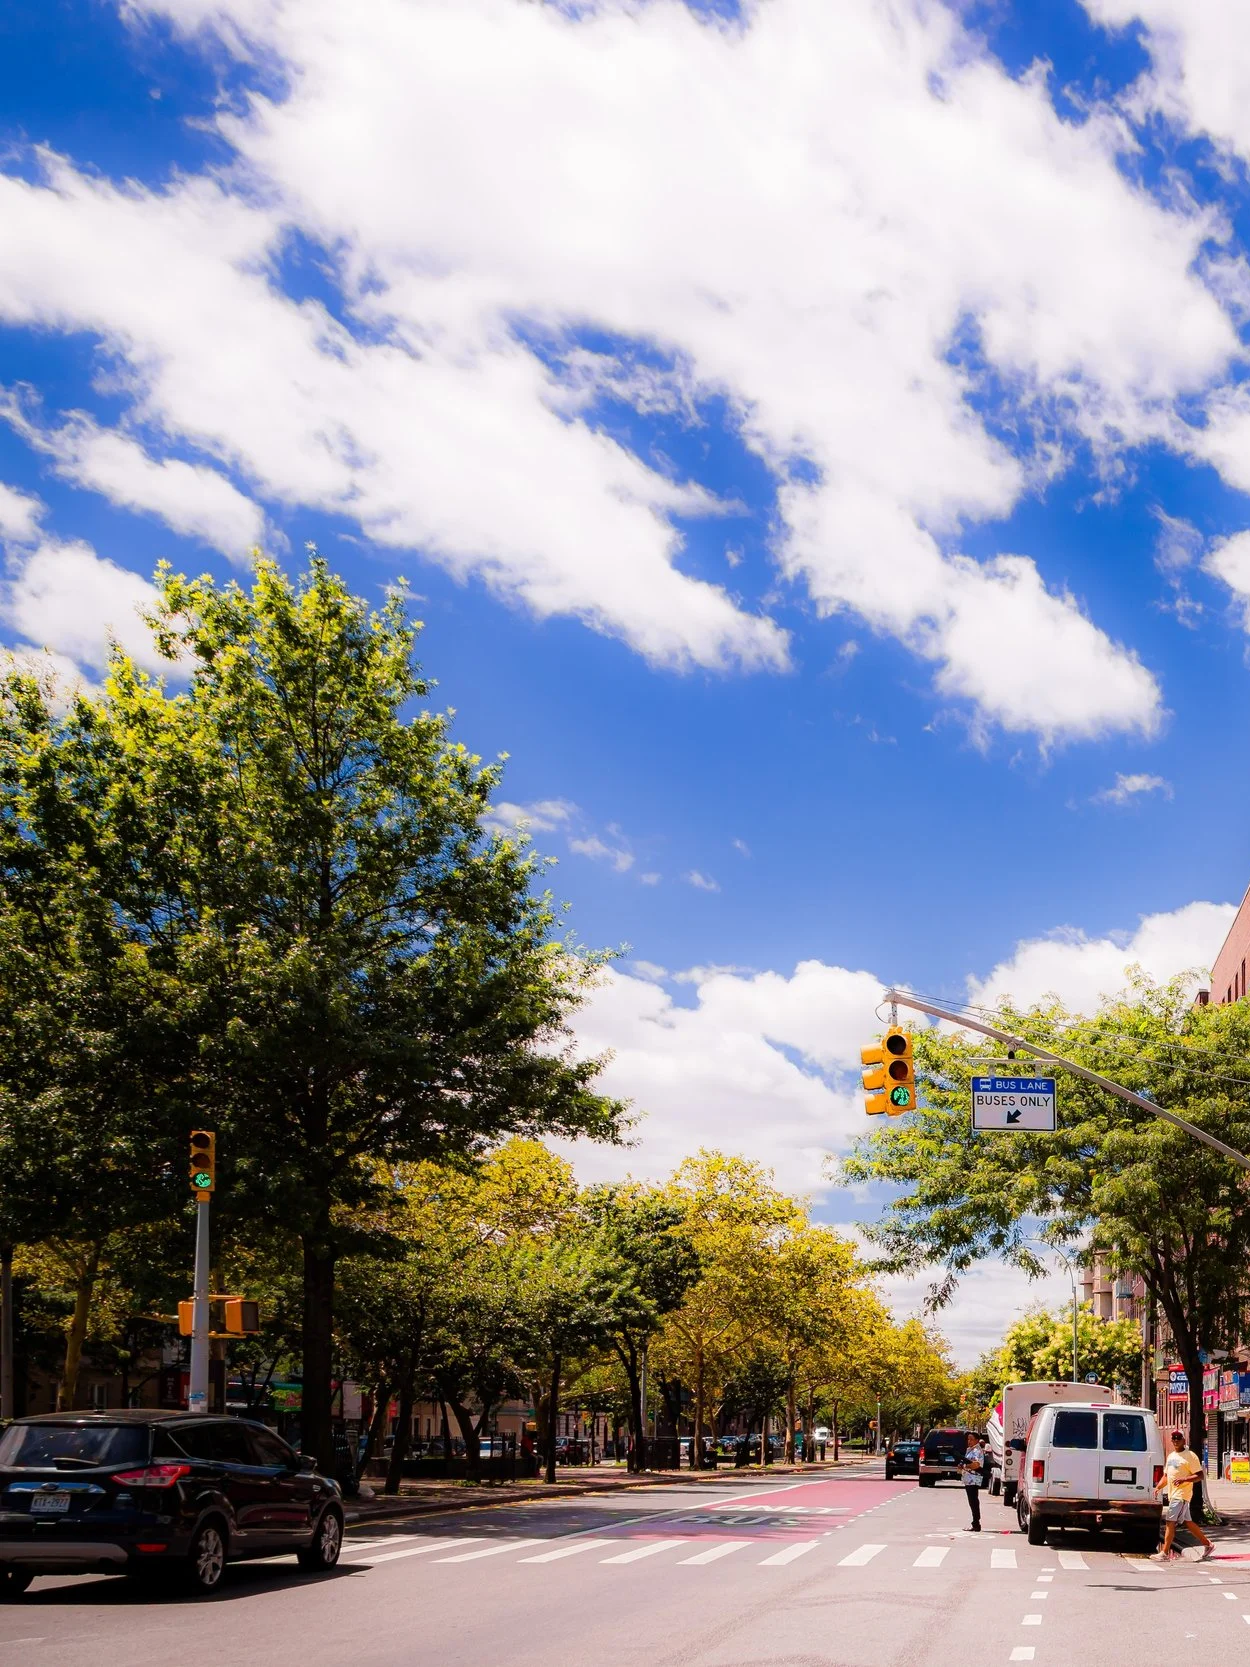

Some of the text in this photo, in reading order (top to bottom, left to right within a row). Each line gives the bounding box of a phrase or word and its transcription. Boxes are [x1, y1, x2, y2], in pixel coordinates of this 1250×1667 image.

[996, 1081, 1048, 1090] BUS LANE
[977, 1095, 1050, 1107] BUSES ONLY
[712, 1505, 853, 1514] ONLY
[664, 1515, 802, 1526] BUS
